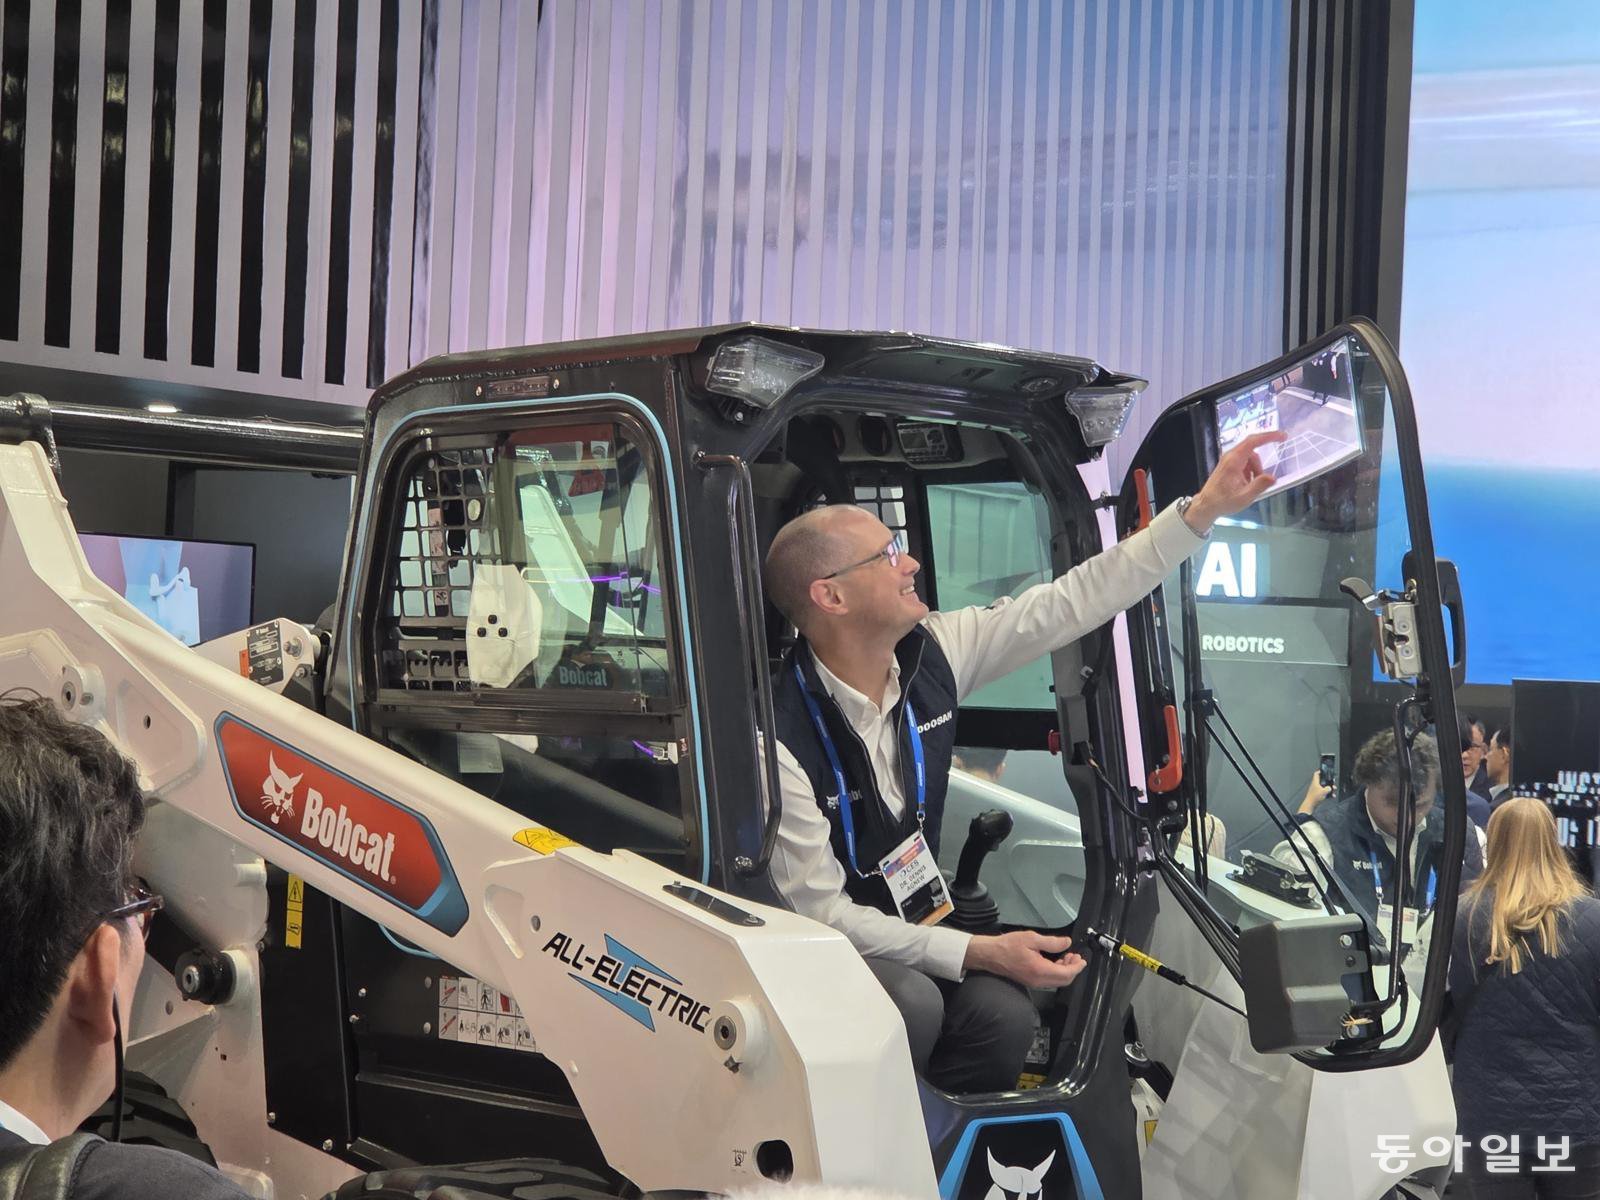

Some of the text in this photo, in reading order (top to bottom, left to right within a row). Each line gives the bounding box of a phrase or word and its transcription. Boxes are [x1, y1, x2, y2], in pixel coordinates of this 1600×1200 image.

[1195, 541, 1257, 598] AI
[1202, 634, 1285, 654] ROBOTICS
[560, 666, 607, 687] Bobcat
[917, 710, 952, 734] DOOSAN
[301, 787, 395, 882] Bobcat
[541, 931, 711, 1034] ALL-ELECTRIC
